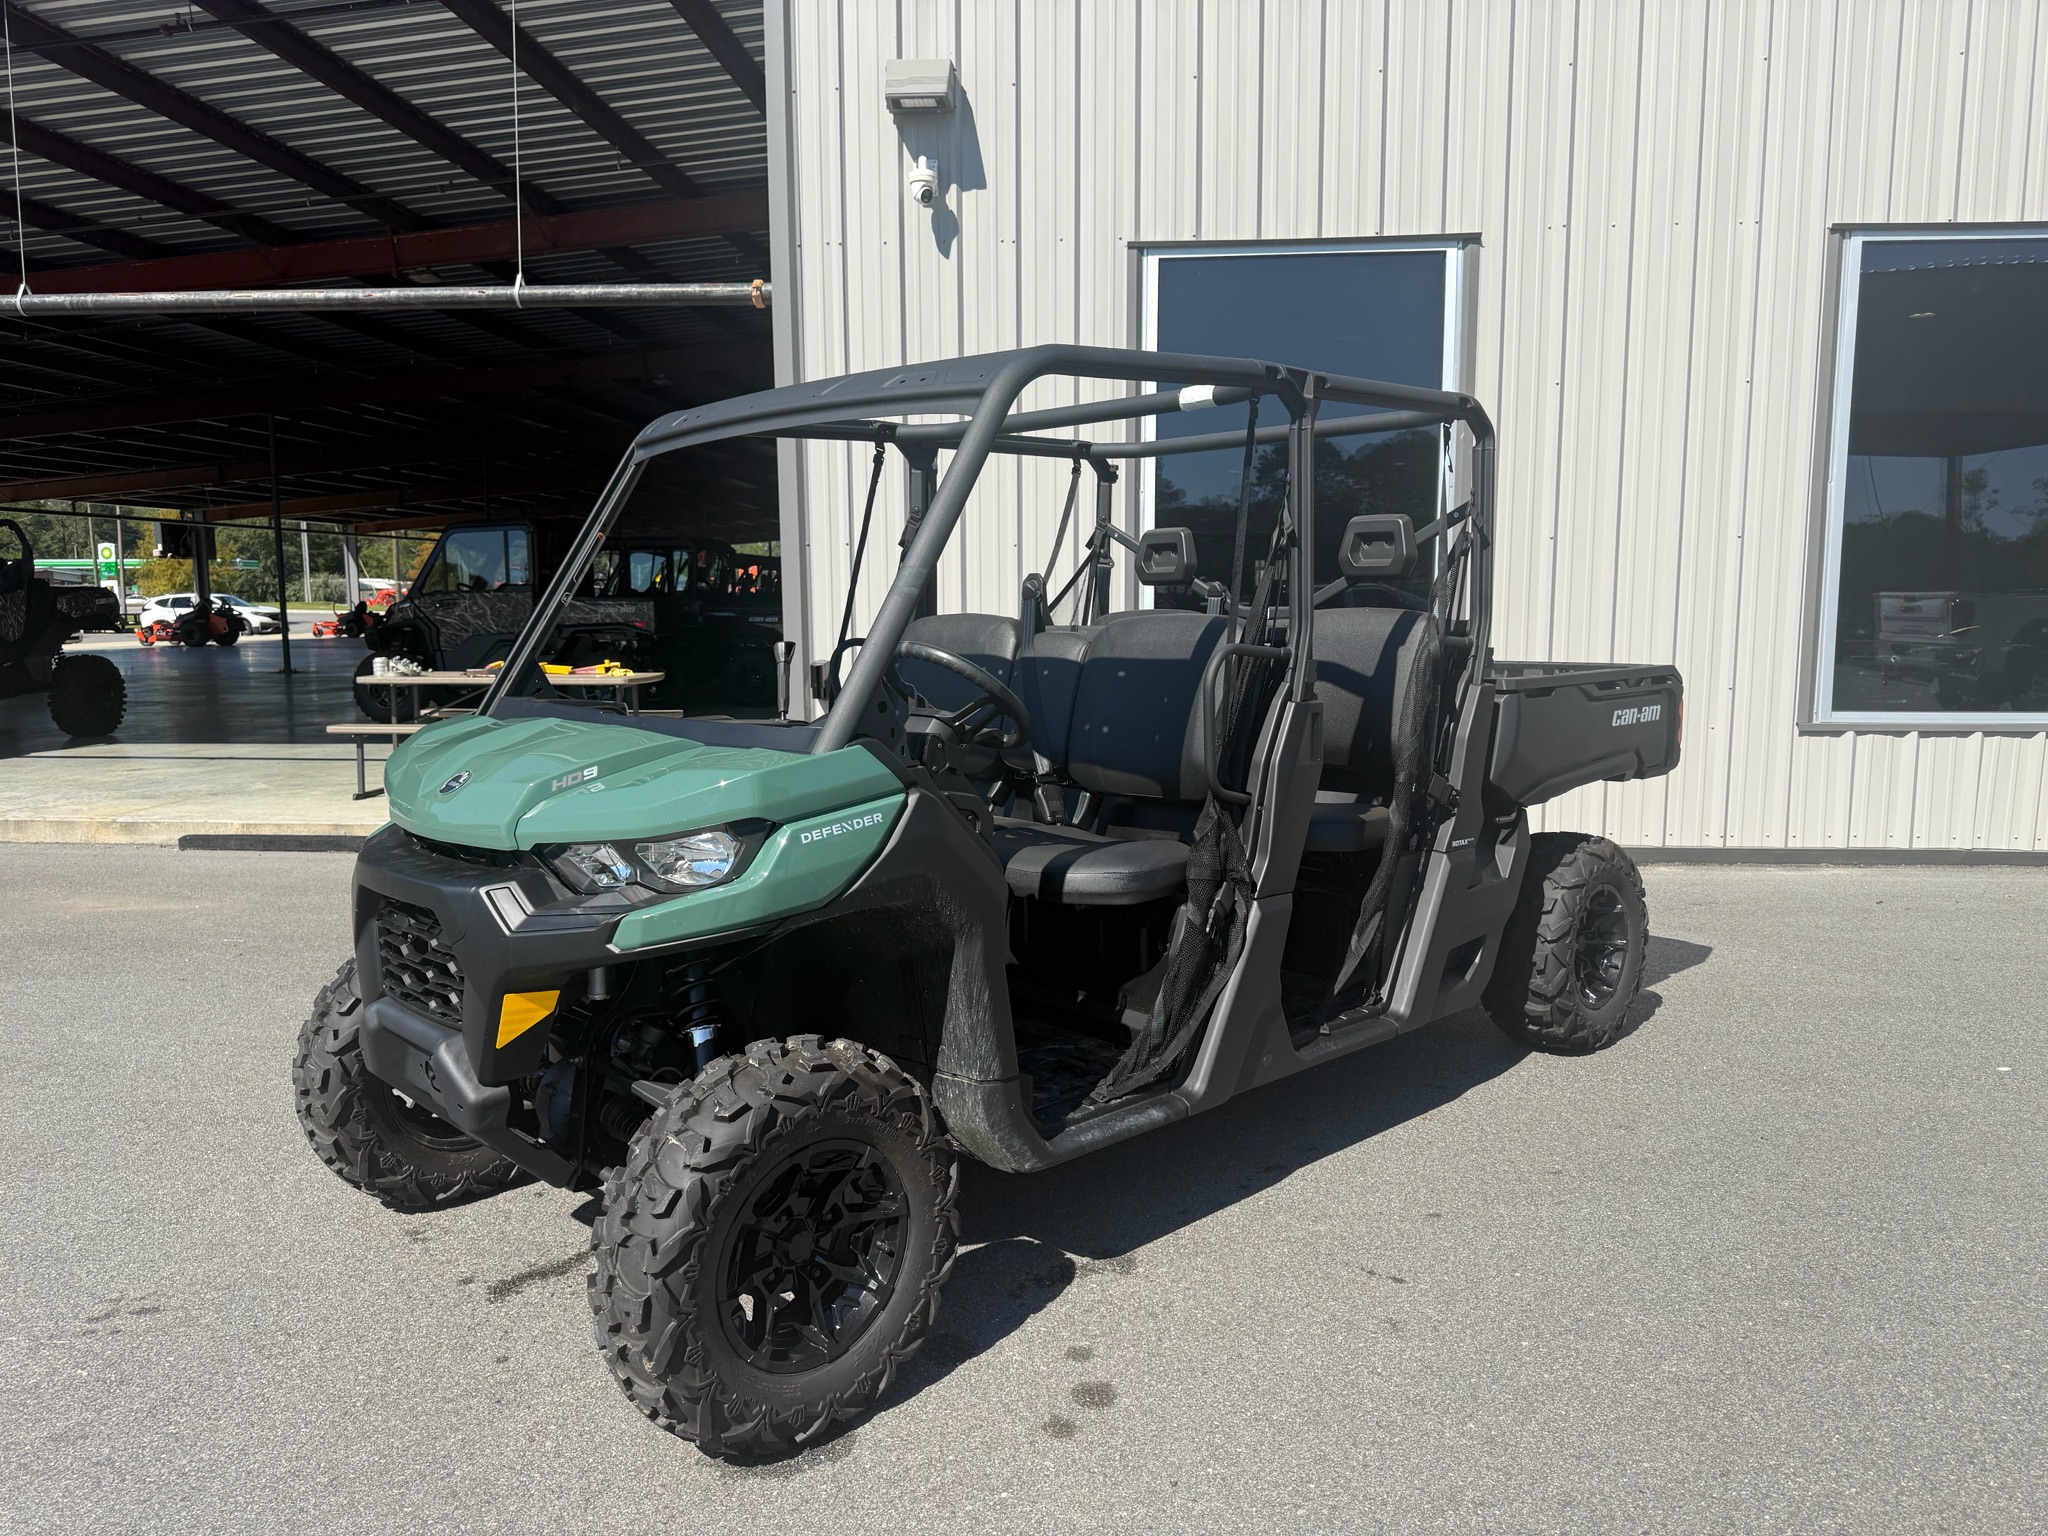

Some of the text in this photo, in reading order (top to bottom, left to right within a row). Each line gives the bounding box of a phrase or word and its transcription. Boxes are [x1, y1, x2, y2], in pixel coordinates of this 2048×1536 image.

[1611, 704, 1661, 727] can-am
[551, 765, 598, 792] HD9
[800, 812, 883, 844] DEFENDER
[1451, 839, 1469, 848] ROTAX
